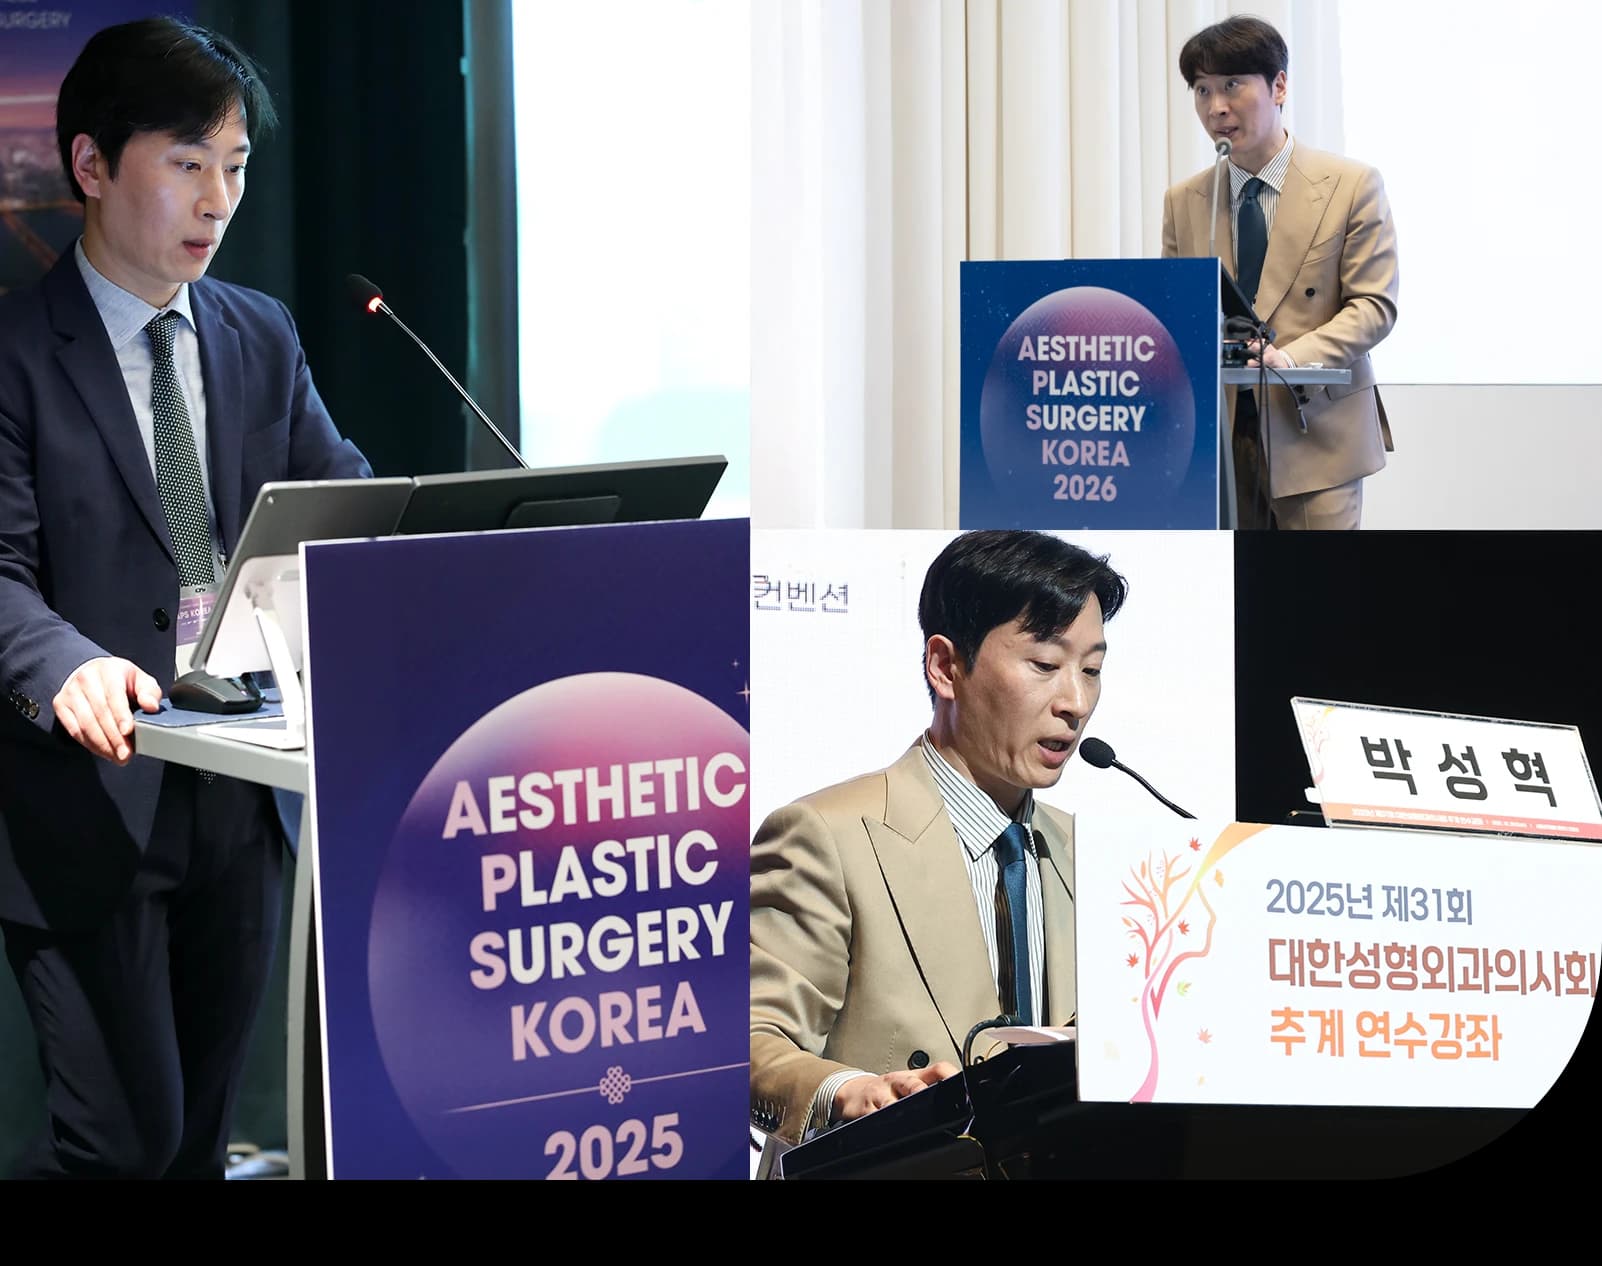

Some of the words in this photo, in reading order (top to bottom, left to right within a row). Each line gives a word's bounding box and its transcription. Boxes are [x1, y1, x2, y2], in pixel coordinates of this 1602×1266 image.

[1017, 335, 1156, 362] AESTHETIC
[1032, 370, 1140, 396] PLASTIC
[1025, 404, 1146, 432] SURGERY
[1041, 439, 1130, 467] KOREA
[1053, 474, 1118, 502] 2026
[441, 751, 747, 839] AESTHETIC
[480, 829, 720, 912] PLASTIC
[1266, 879, 1374, 920] 2025년
[1381, 884, 1473, 925] 제31회
[469, 900, 734, 990] SURGERY
[1268, 938, 1597, 998] 대한성형외과의사회
[510, 981, 707, 1061] KOREA
[1270, 1006, 1345, 1058] 추계
[1355, 1010, 1503, 1061] 연수강좌
[544, 1113, 684, 1180] 2025
